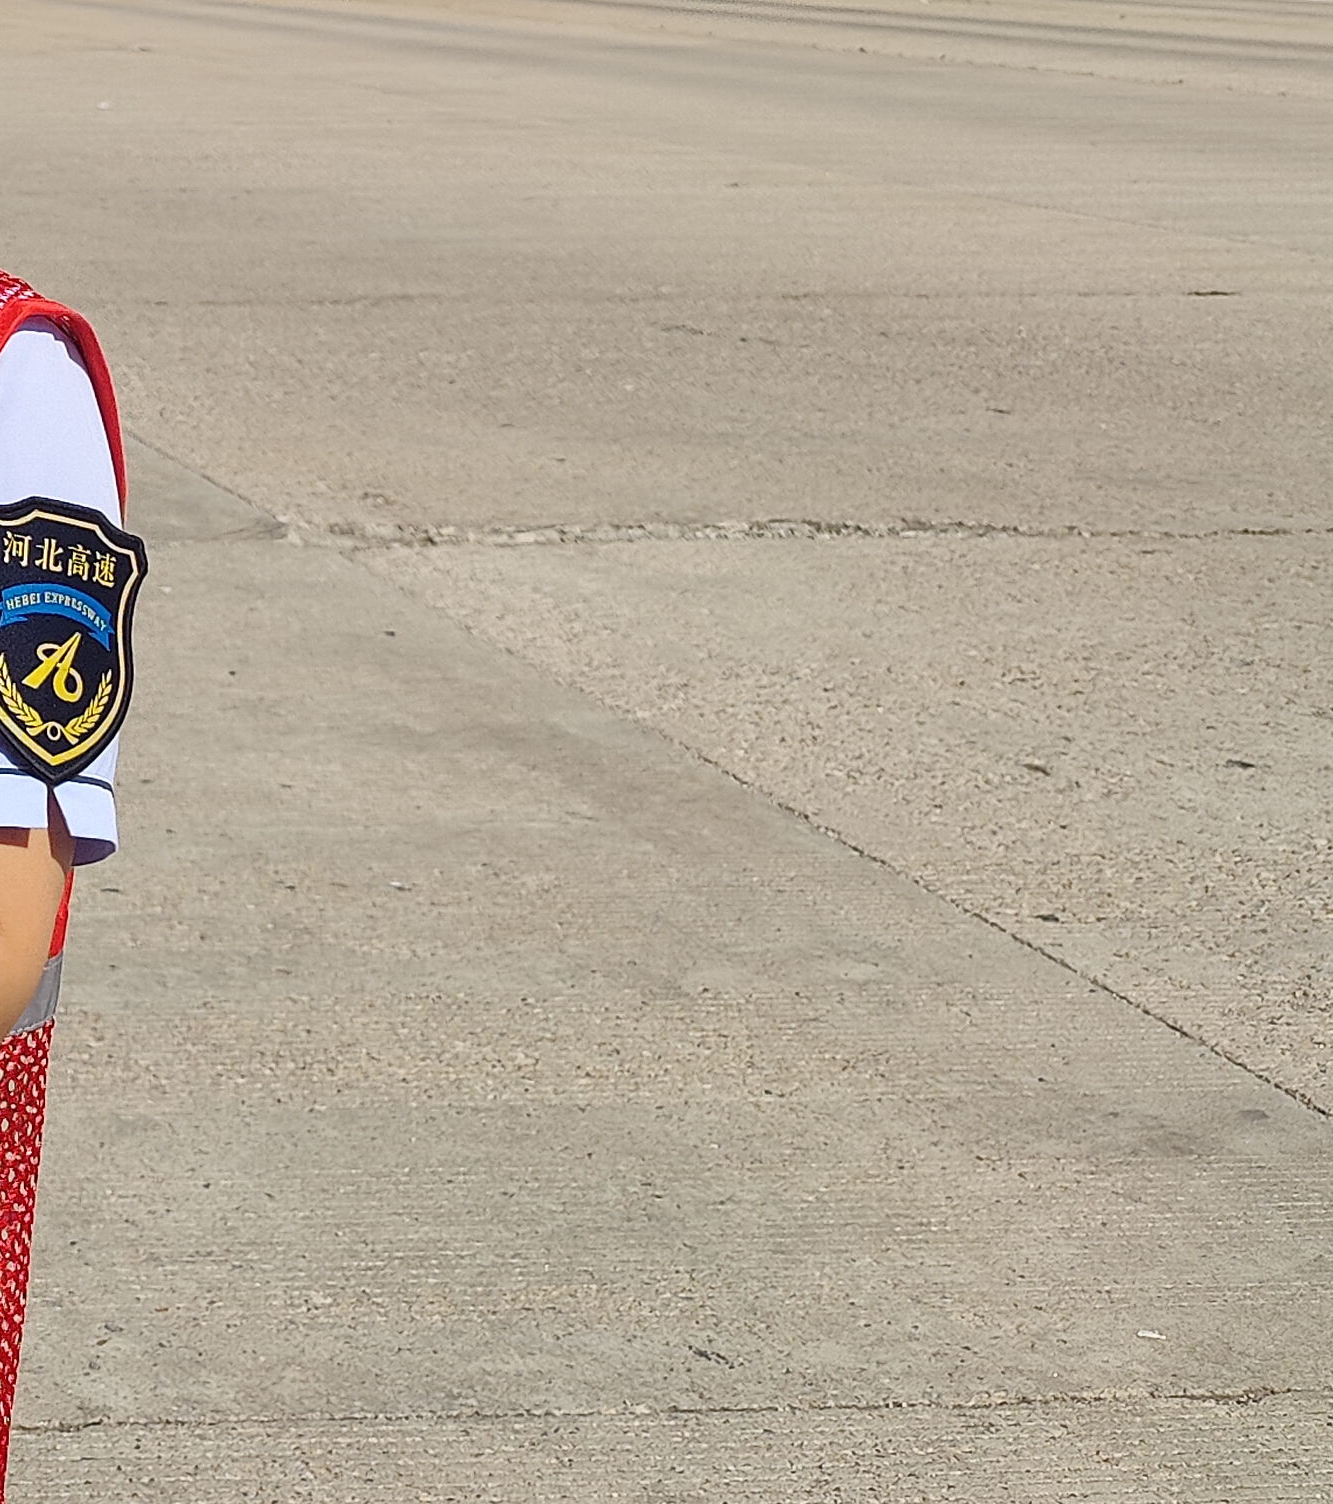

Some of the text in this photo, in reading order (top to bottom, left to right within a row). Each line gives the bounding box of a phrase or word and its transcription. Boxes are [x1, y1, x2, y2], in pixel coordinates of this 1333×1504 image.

[2, 531, 117, 588] 河北高速
[6, 591, 107, 632] HEBEI EXPRESSWAY
